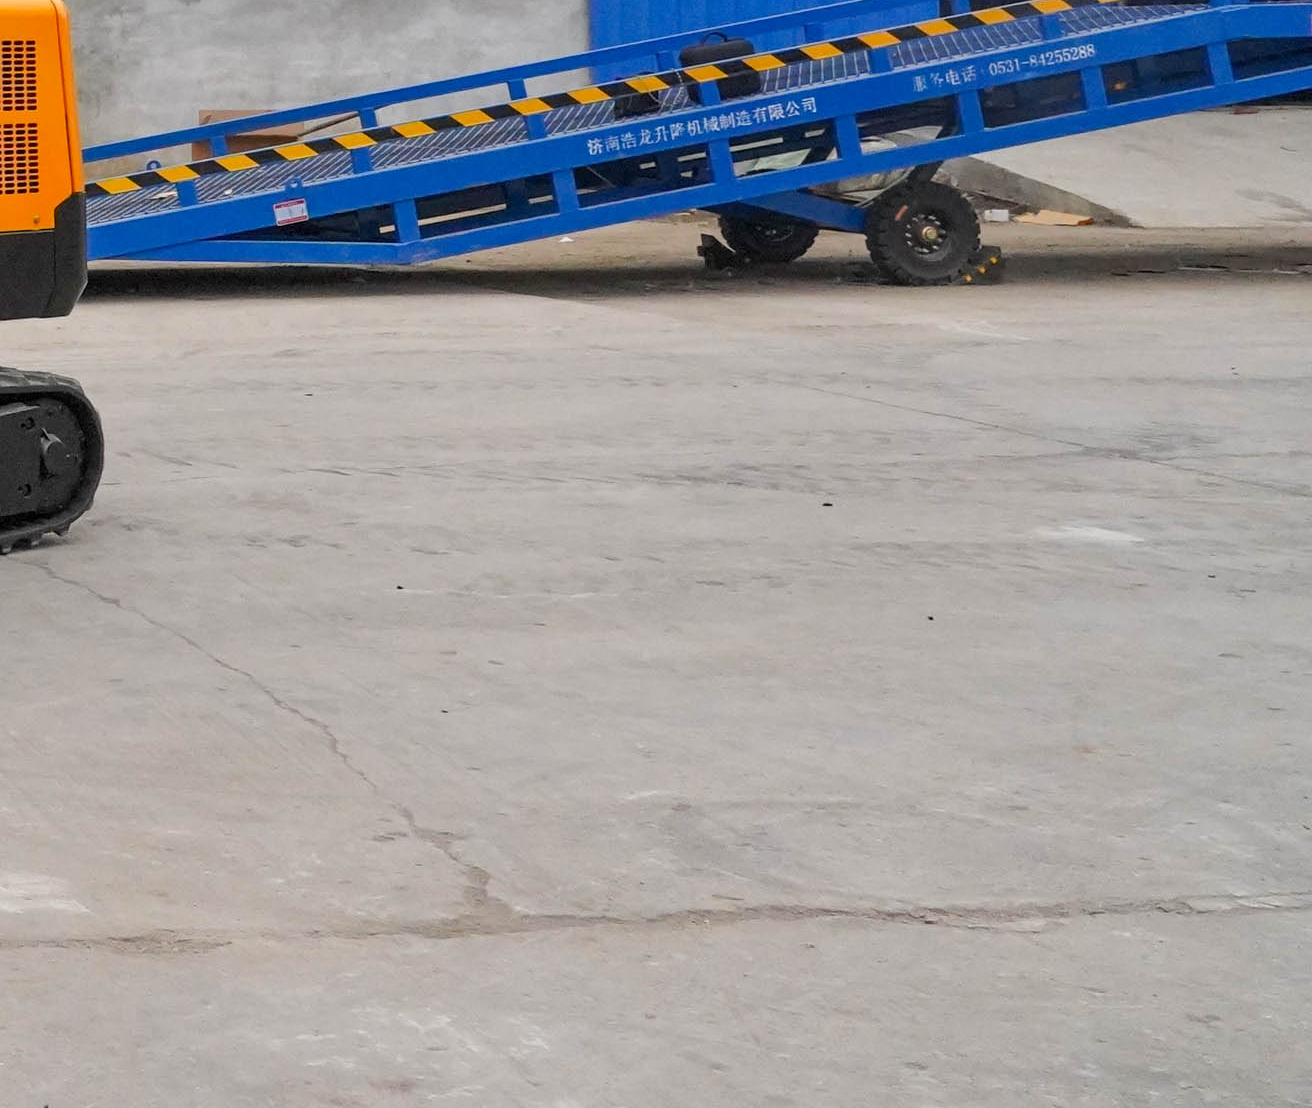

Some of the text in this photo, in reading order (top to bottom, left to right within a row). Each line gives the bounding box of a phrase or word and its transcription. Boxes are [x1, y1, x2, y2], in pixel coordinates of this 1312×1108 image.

[988, 44, 1096, 76] 0531-84255288
[587, 97, 816, 155] 济南浩龙升降机械制造有限公司
